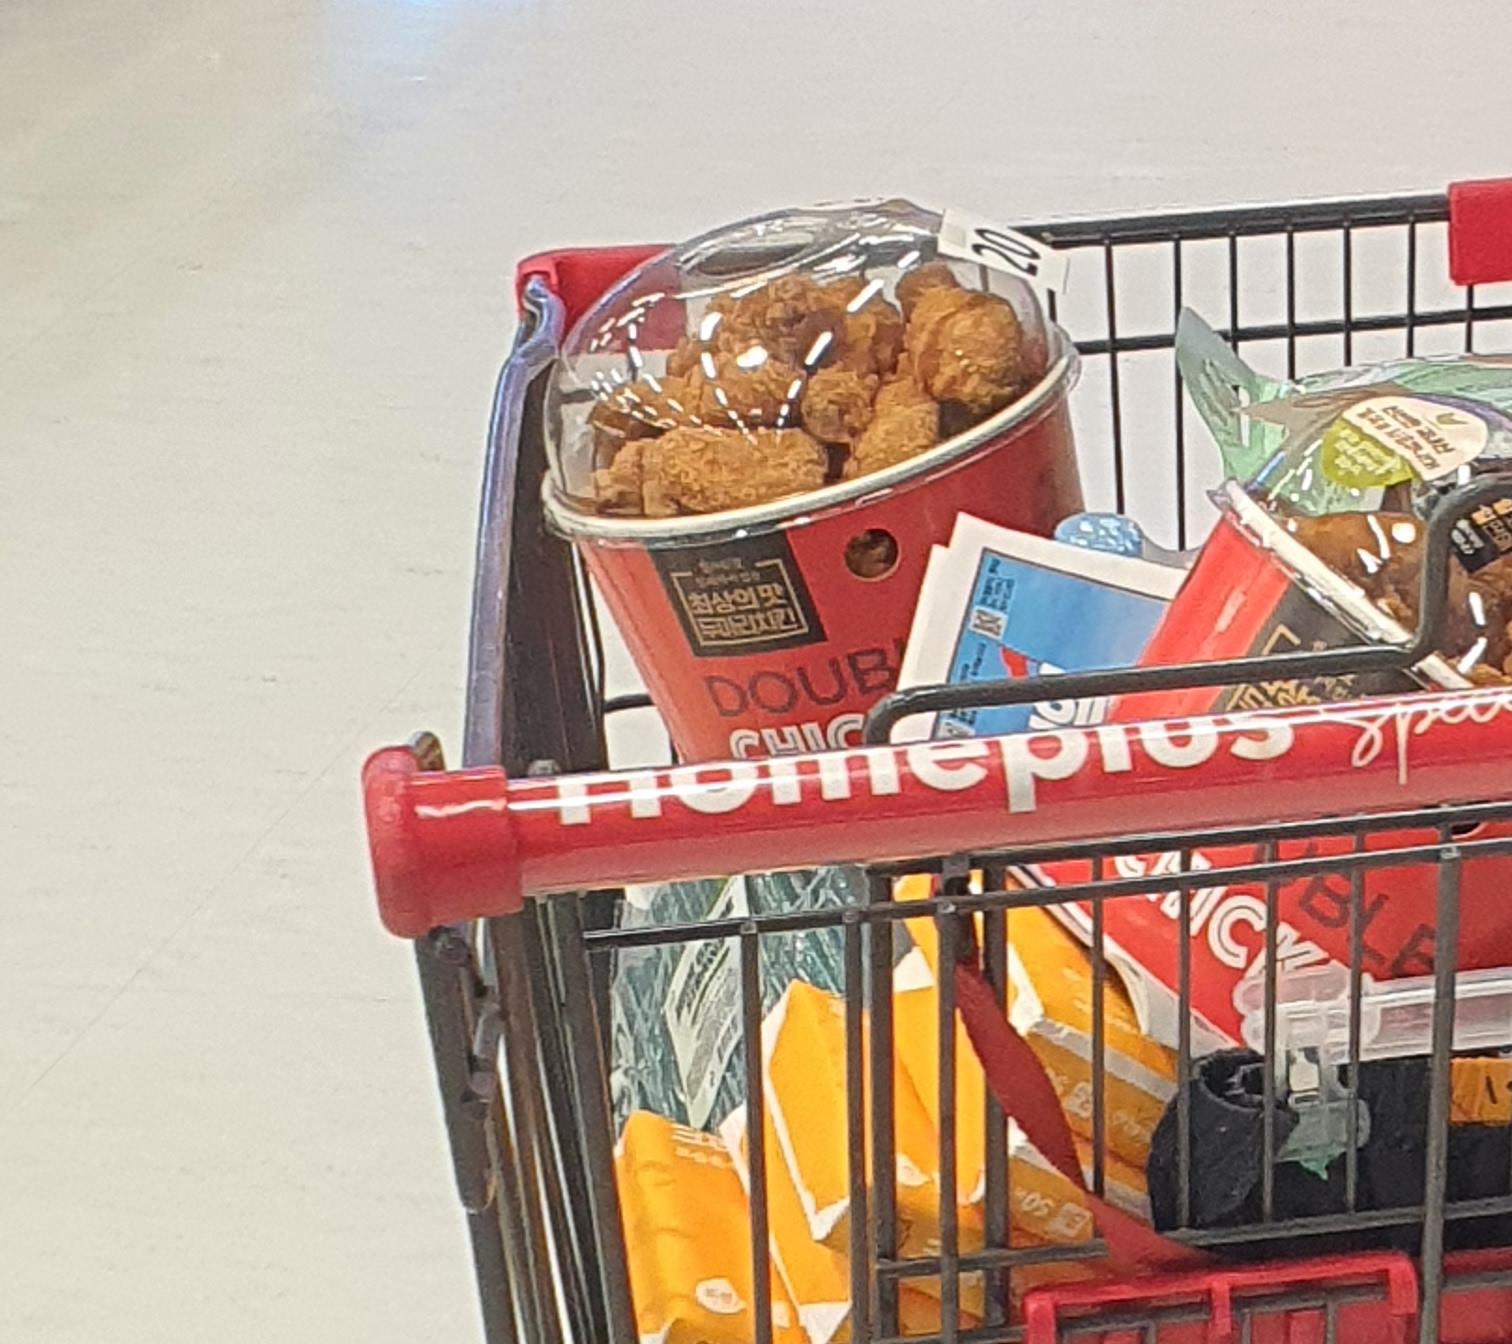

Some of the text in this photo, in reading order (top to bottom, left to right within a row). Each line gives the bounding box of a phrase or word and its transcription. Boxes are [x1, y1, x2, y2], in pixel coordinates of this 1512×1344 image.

[687, 582, 788, 615] 최상의 맛
[704, 639, 903, 717] DOUB
[557, 708, 1296, 825] homeplus
